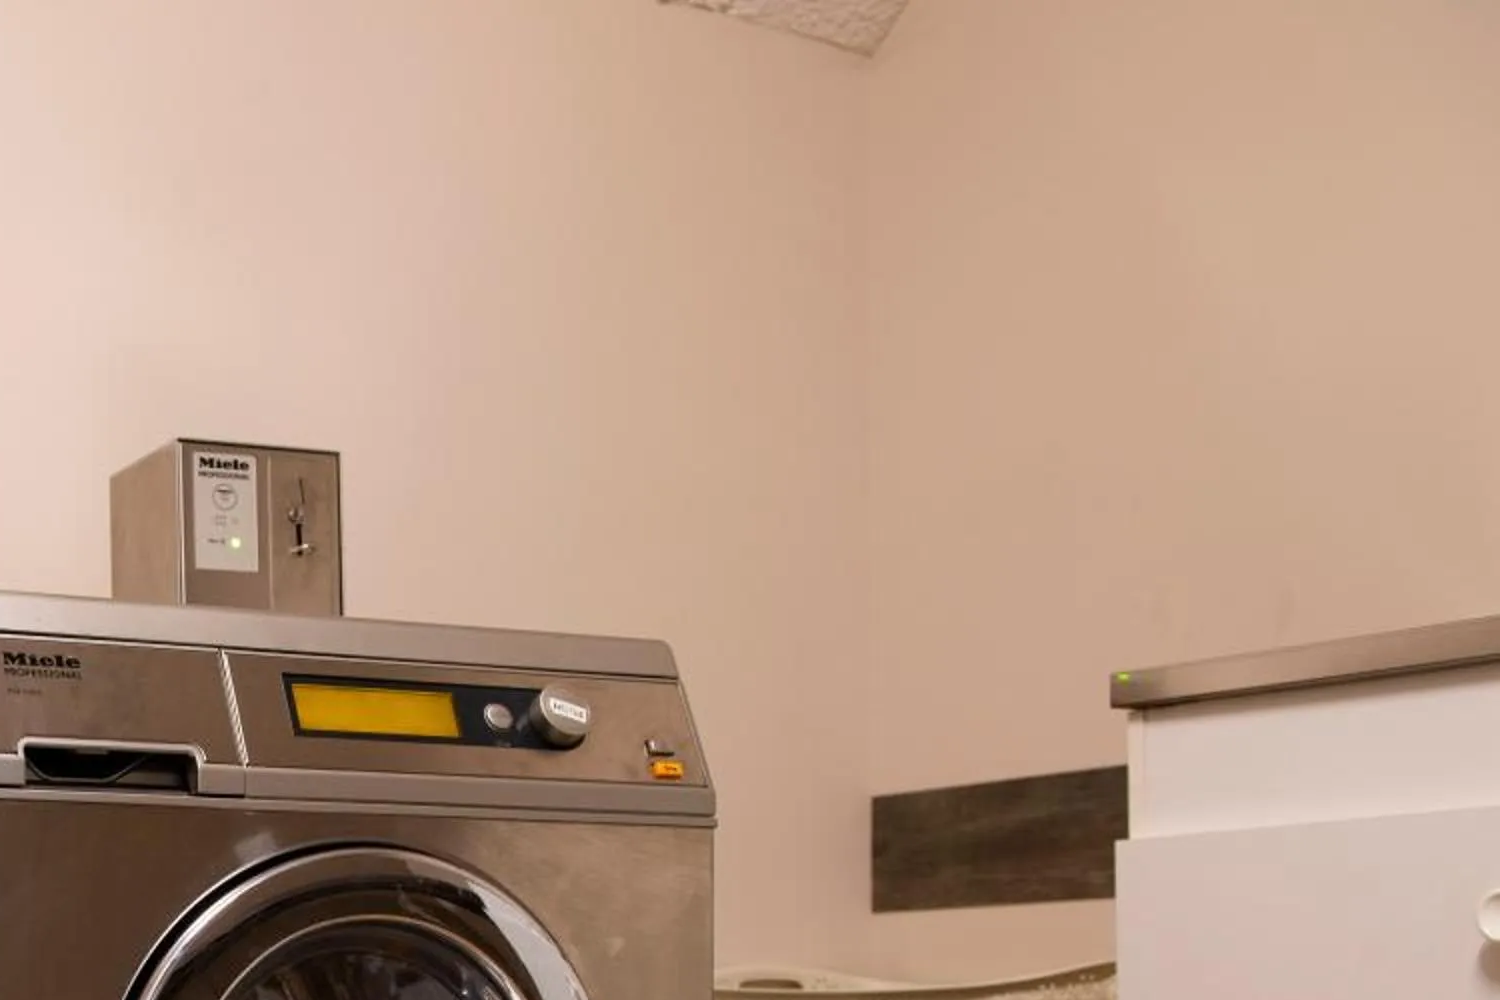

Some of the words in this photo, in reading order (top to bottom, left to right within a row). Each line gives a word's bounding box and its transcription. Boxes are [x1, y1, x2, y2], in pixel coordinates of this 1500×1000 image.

[199, 456, 250, 471] Miele
[3, 652, 81, 669] Miele
[4, 667, 82, 681] PROFESSIONAL
